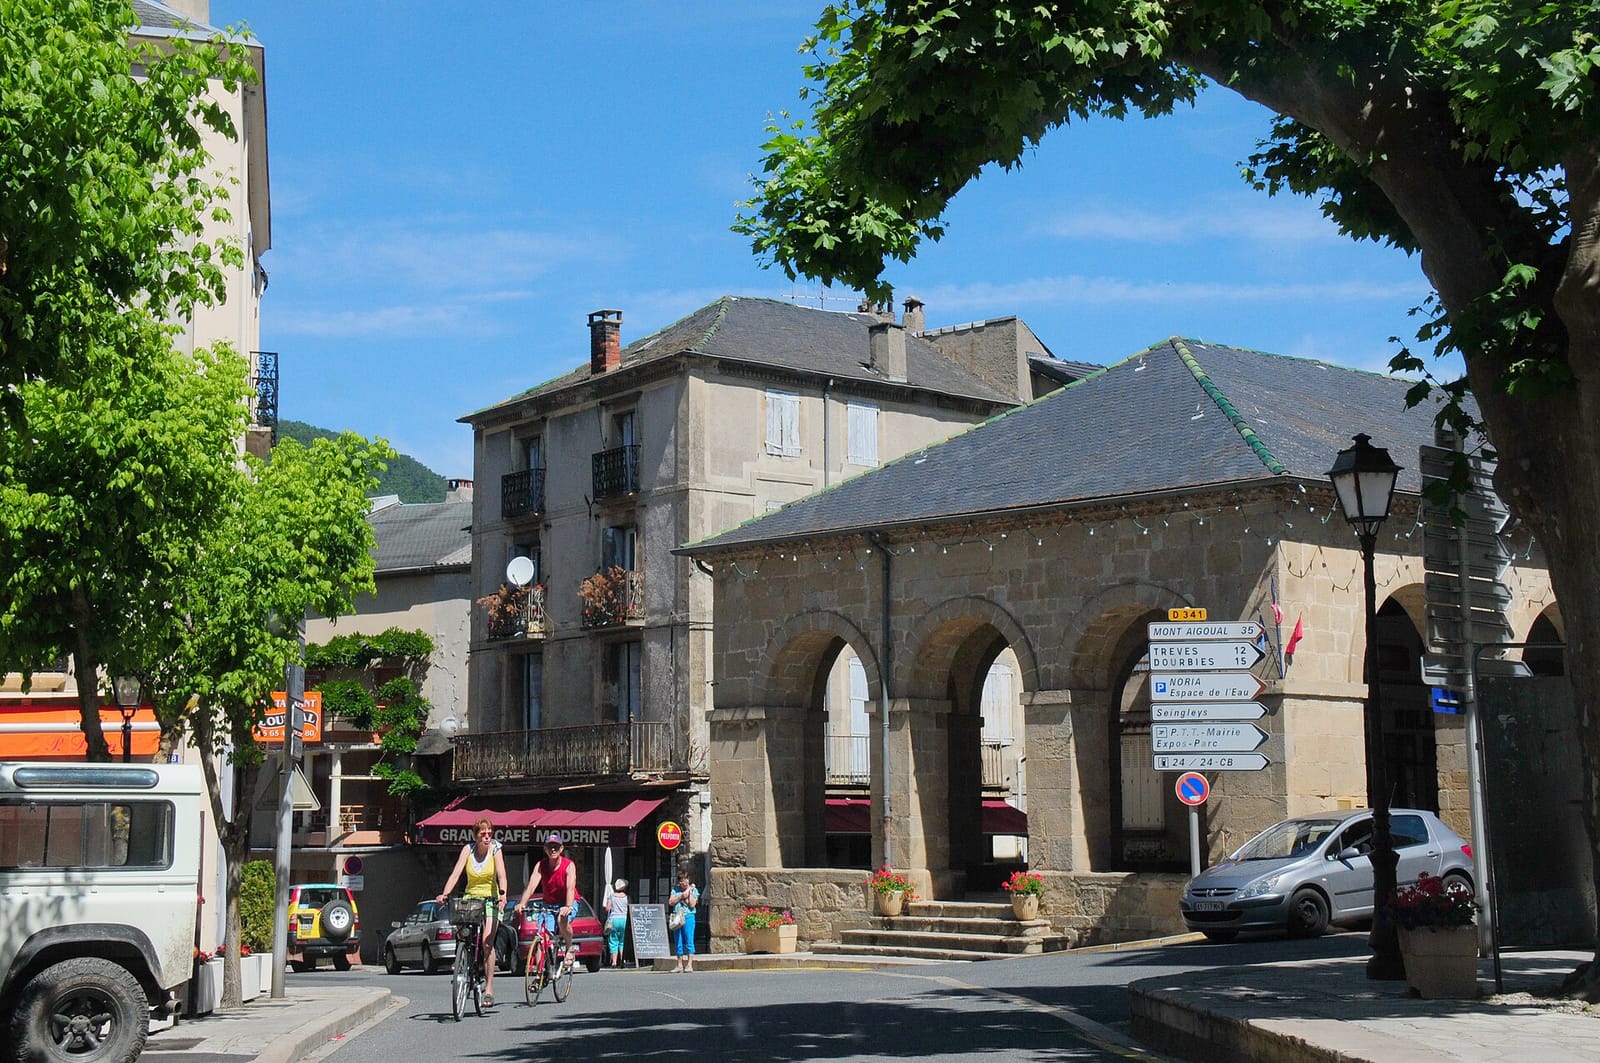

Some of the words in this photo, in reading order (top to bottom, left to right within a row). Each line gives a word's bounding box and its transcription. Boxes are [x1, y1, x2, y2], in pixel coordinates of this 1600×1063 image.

[1173, 610, 1178, 618] D
[1183, 610, 1202, 618] 341
[1154, 628, 1182, 636] MONT
[1186, 627, 1228, 636] AIGOUAL
[1241, 626, 1254, 634] 35
[1154, 648, 1198, 656] TREVES
[1235, 646, 1246, 654] 12
[1154, 658, 1214, 666] DOURBIES
[1235, 657, 1246, 665] 15
[1170, 678, 1200, 686] NORIA
[1170, 689, 1204, 698] Espace
[1209, 688, 1220, 696] de
[1226, 688, 1249, 696] l'Eau
[1156, 708, 1208, 718] Seingleys
[1172, 758, 1185, 766] 24
[440, 829, 476, 842] GRAN
[494, 829, 530, 842] CAFE
